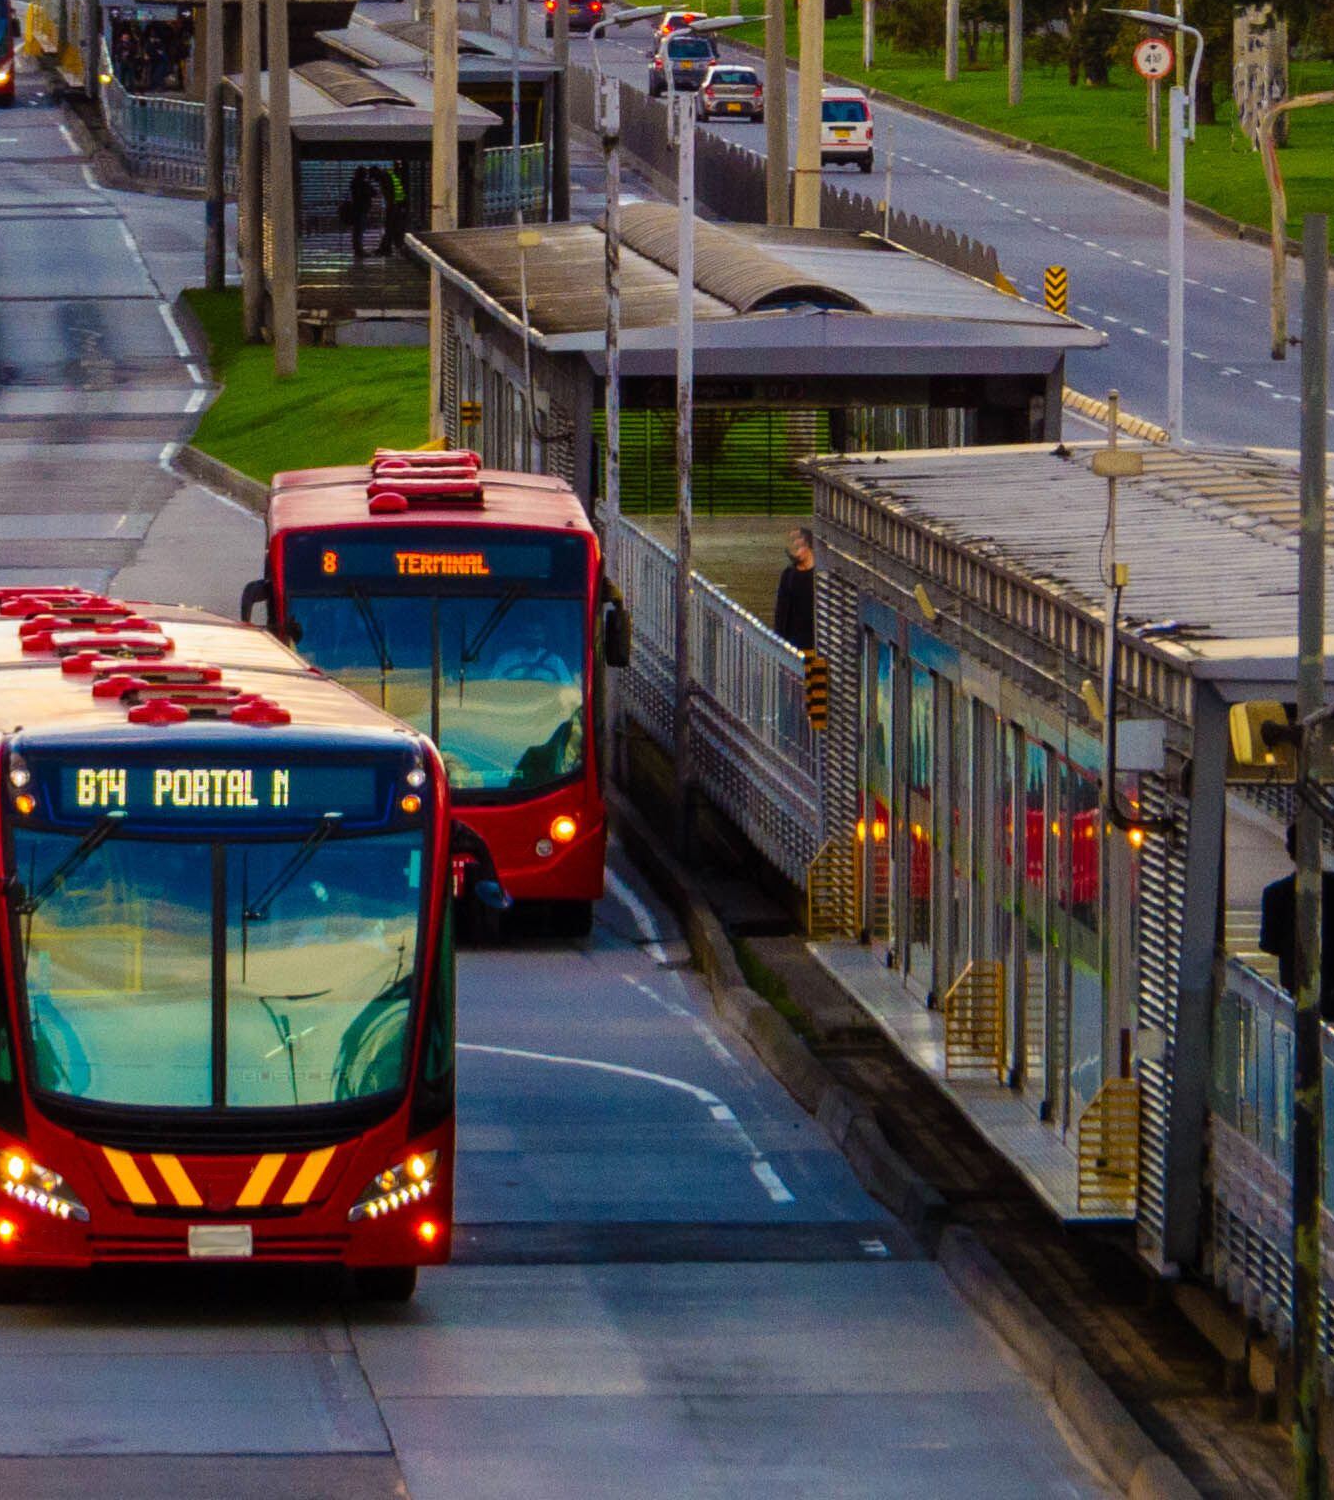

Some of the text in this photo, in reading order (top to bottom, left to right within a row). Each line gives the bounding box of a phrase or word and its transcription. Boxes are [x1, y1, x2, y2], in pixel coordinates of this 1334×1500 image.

[322, 550, 491, 575] 8 TERMINAL
[77, 768, 289, 807] B14 PORTAL N
